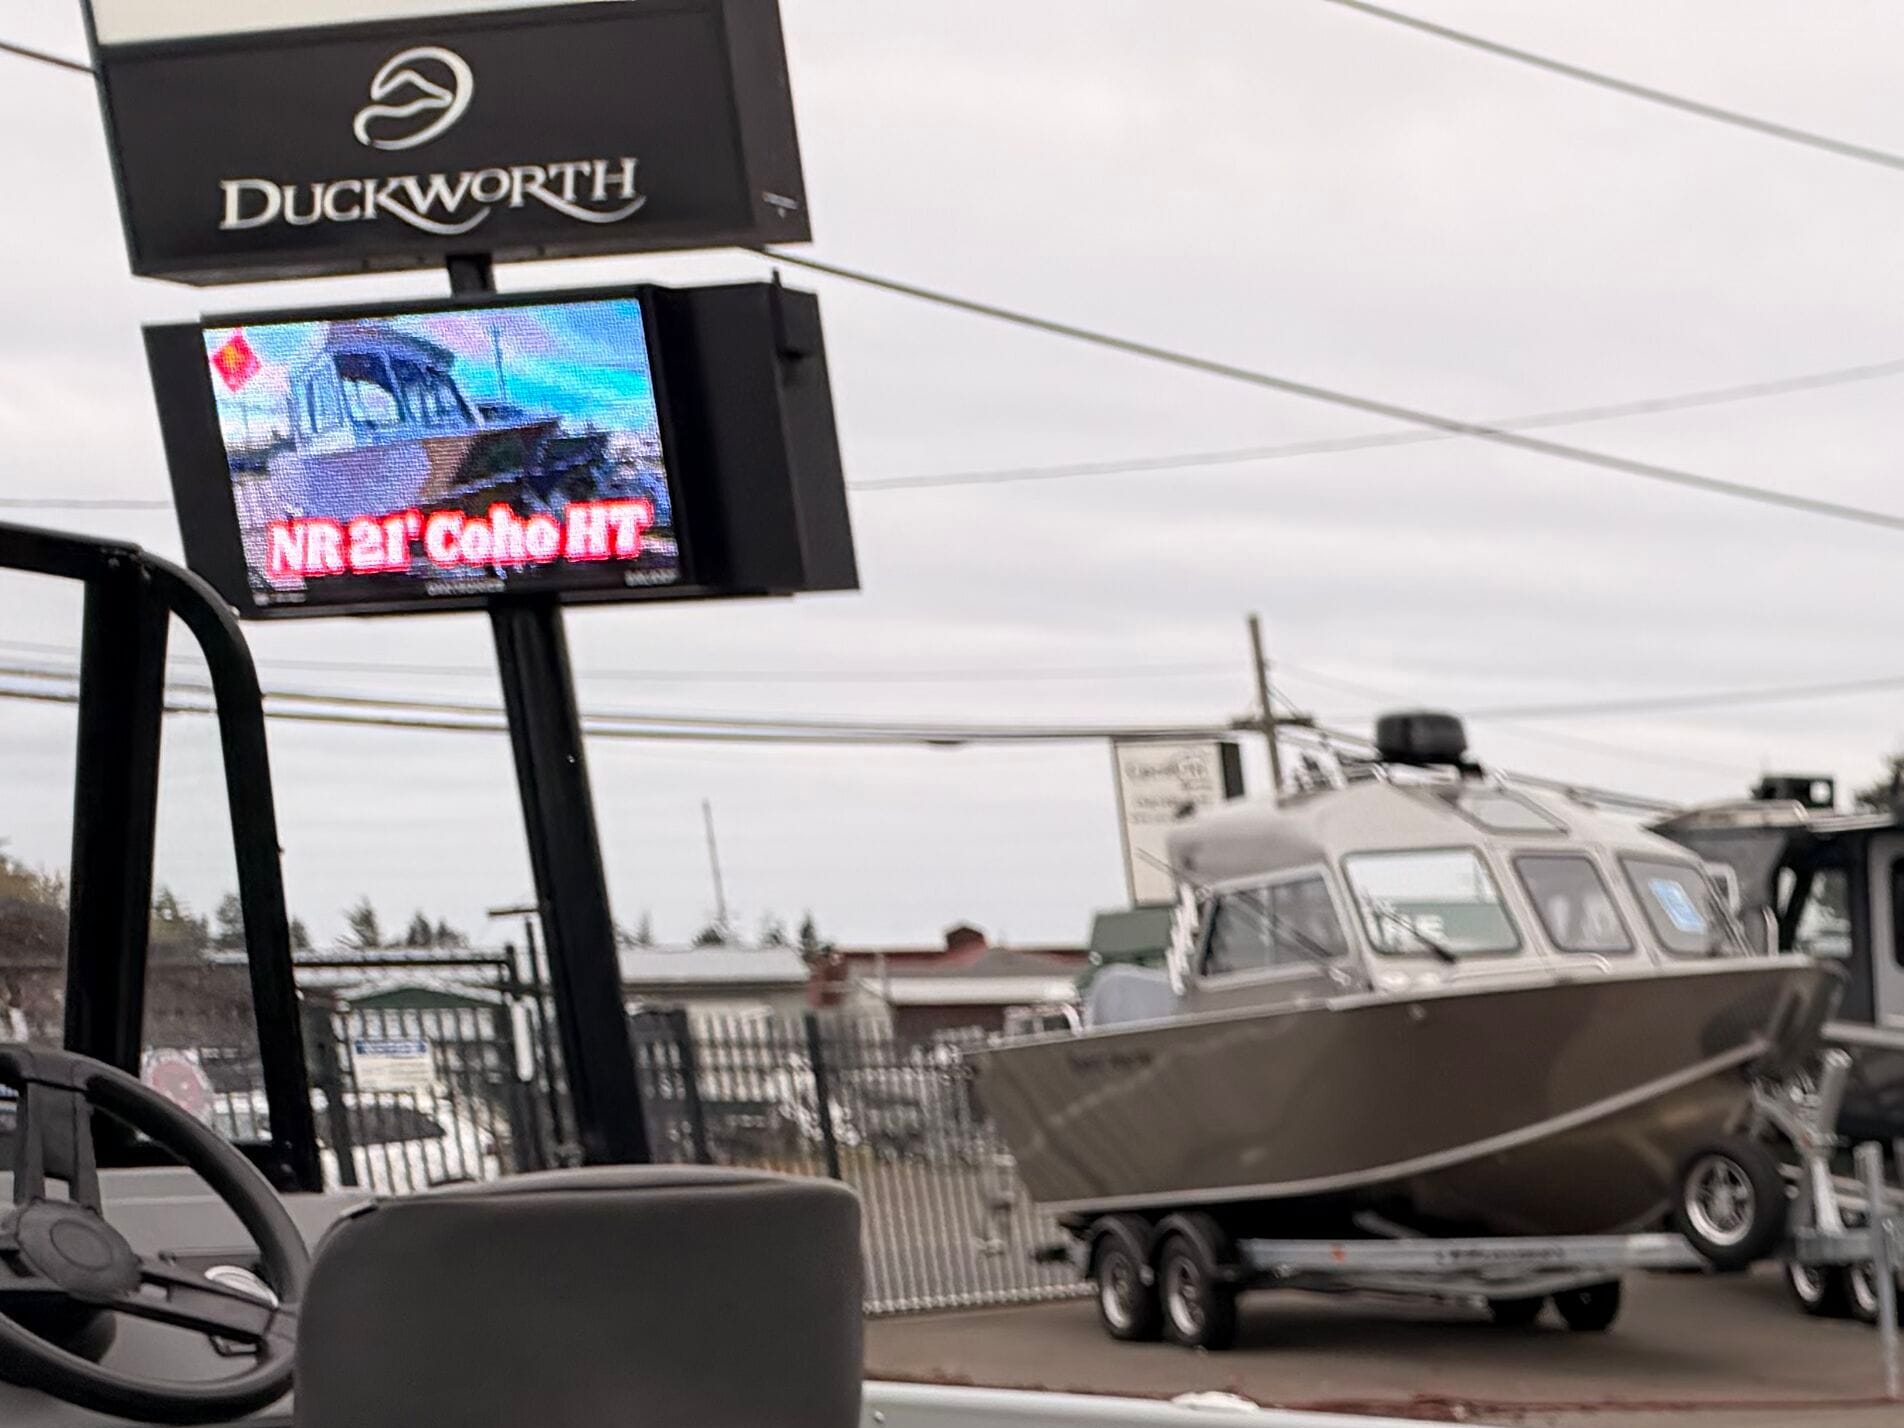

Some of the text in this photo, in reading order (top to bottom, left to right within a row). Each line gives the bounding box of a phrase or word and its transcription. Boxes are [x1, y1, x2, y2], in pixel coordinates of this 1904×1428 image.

[219, 157, 646, 234] DUCKWORTH
[267, 518, 345, 578] NR
[425, 502, 561, 568] Coho
[563, 497, 655, 562] HT
